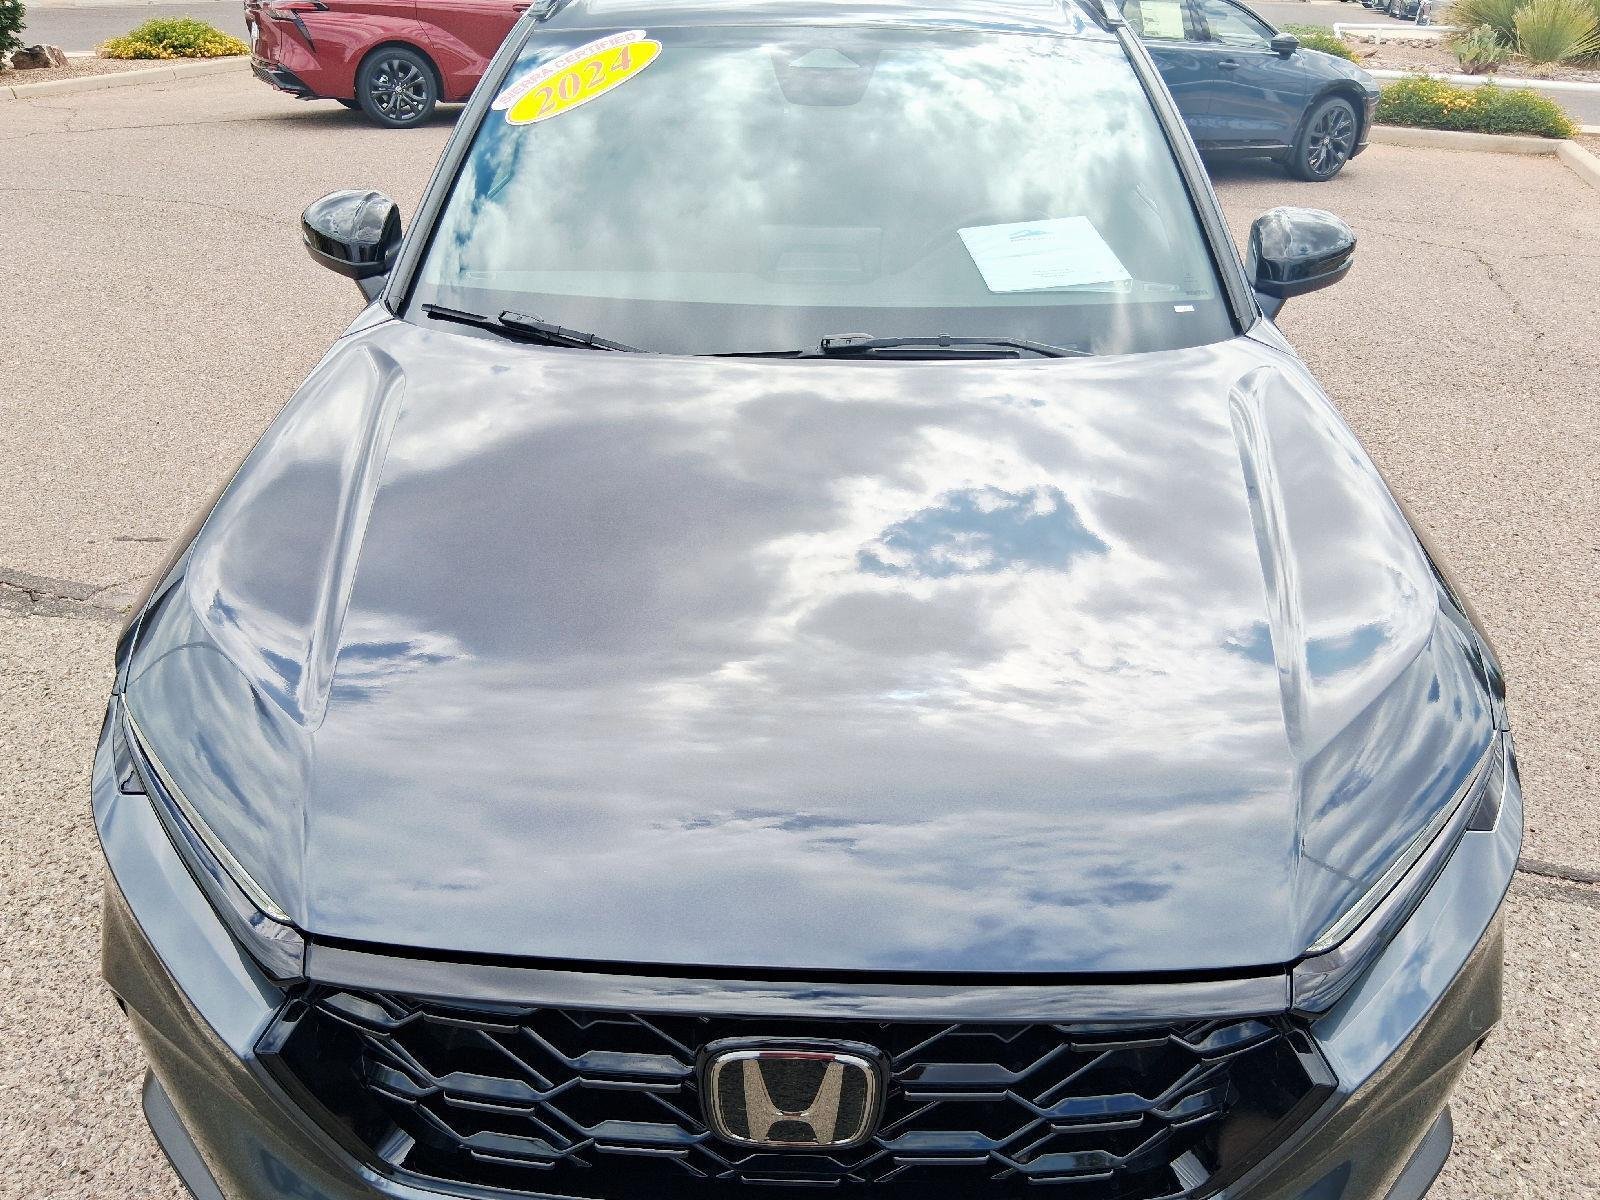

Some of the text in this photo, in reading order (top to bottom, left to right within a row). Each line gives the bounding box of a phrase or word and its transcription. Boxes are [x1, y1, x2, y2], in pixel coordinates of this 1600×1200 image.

[500, 32, 637, 105] SIERRA CERTIFIED
[535, 46, 632, 117] 2024
